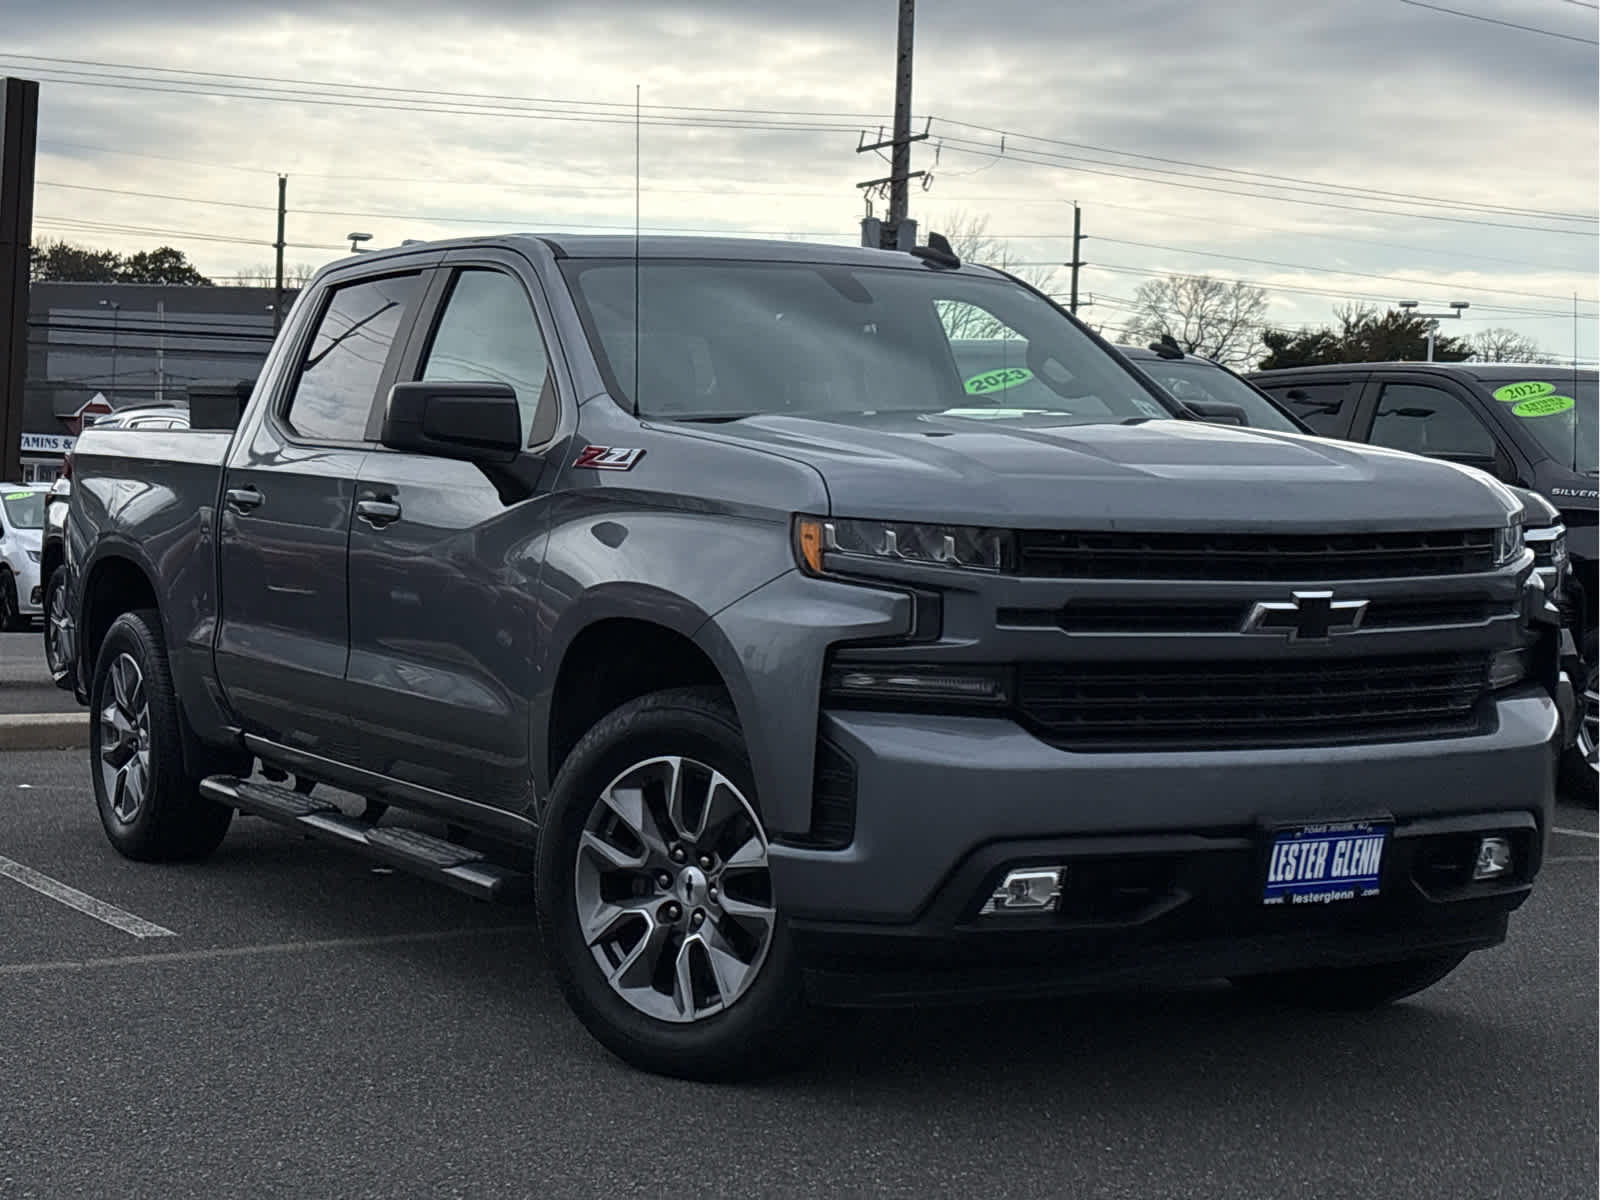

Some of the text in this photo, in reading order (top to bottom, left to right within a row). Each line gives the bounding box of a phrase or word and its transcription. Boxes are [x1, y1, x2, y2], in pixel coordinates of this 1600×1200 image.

[969, 369, 1027, 392] 2023
[1504, 383, 1545, 399] 2022
[63, 438, 73, 449] &
[572, 445, 646, 471] Z71
[1551, 488, 1599, 497] SILVER
[1267, 837, 1385, 882] LESTER GLENN
[1292, 890, 1354, 904] lesterglenn
